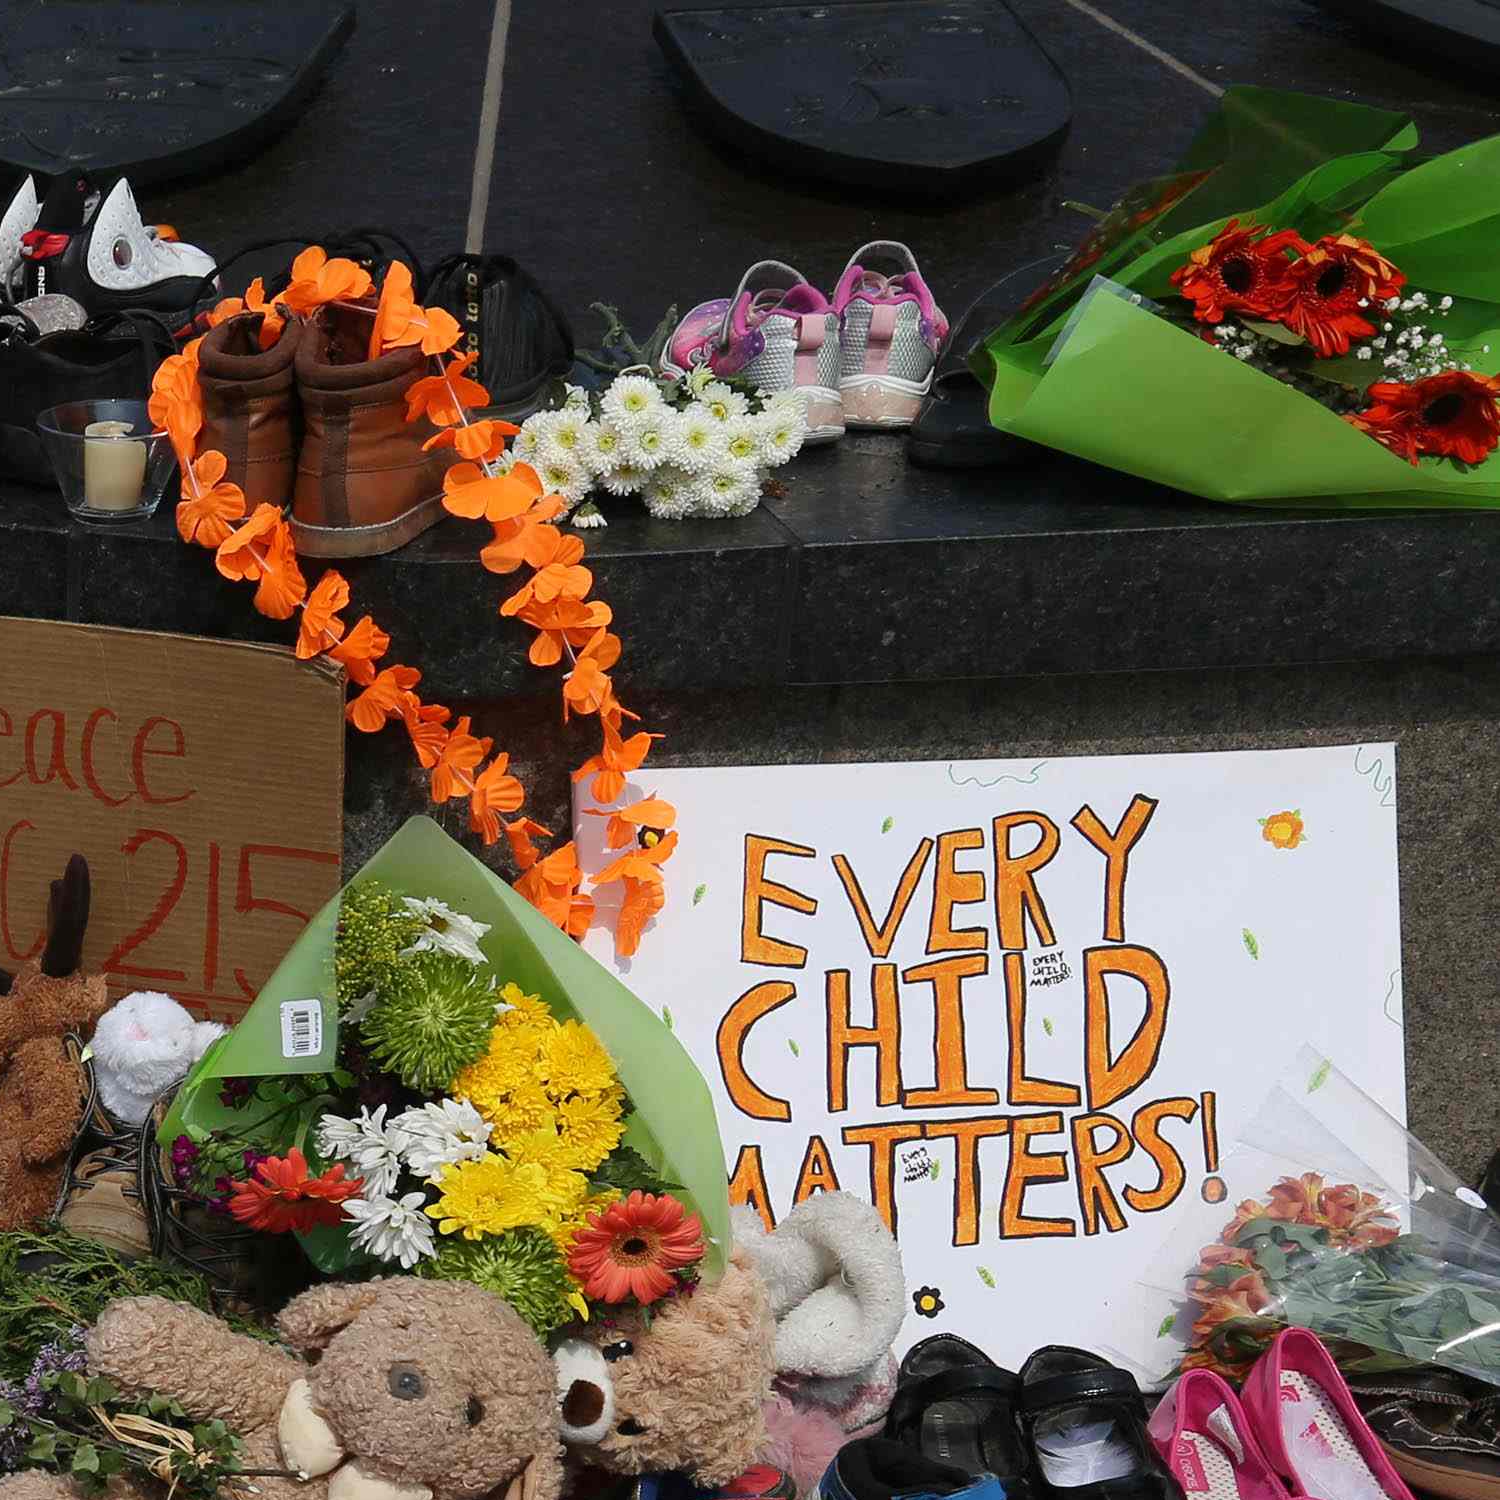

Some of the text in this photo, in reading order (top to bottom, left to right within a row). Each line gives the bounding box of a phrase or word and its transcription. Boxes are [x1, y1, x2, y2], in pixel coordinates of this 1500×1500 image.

[741, 793, 1159, 970] EVERY
[1032, 950, 1064, 967] EVERY
[716, 944, 1171, 1122] CHILD
